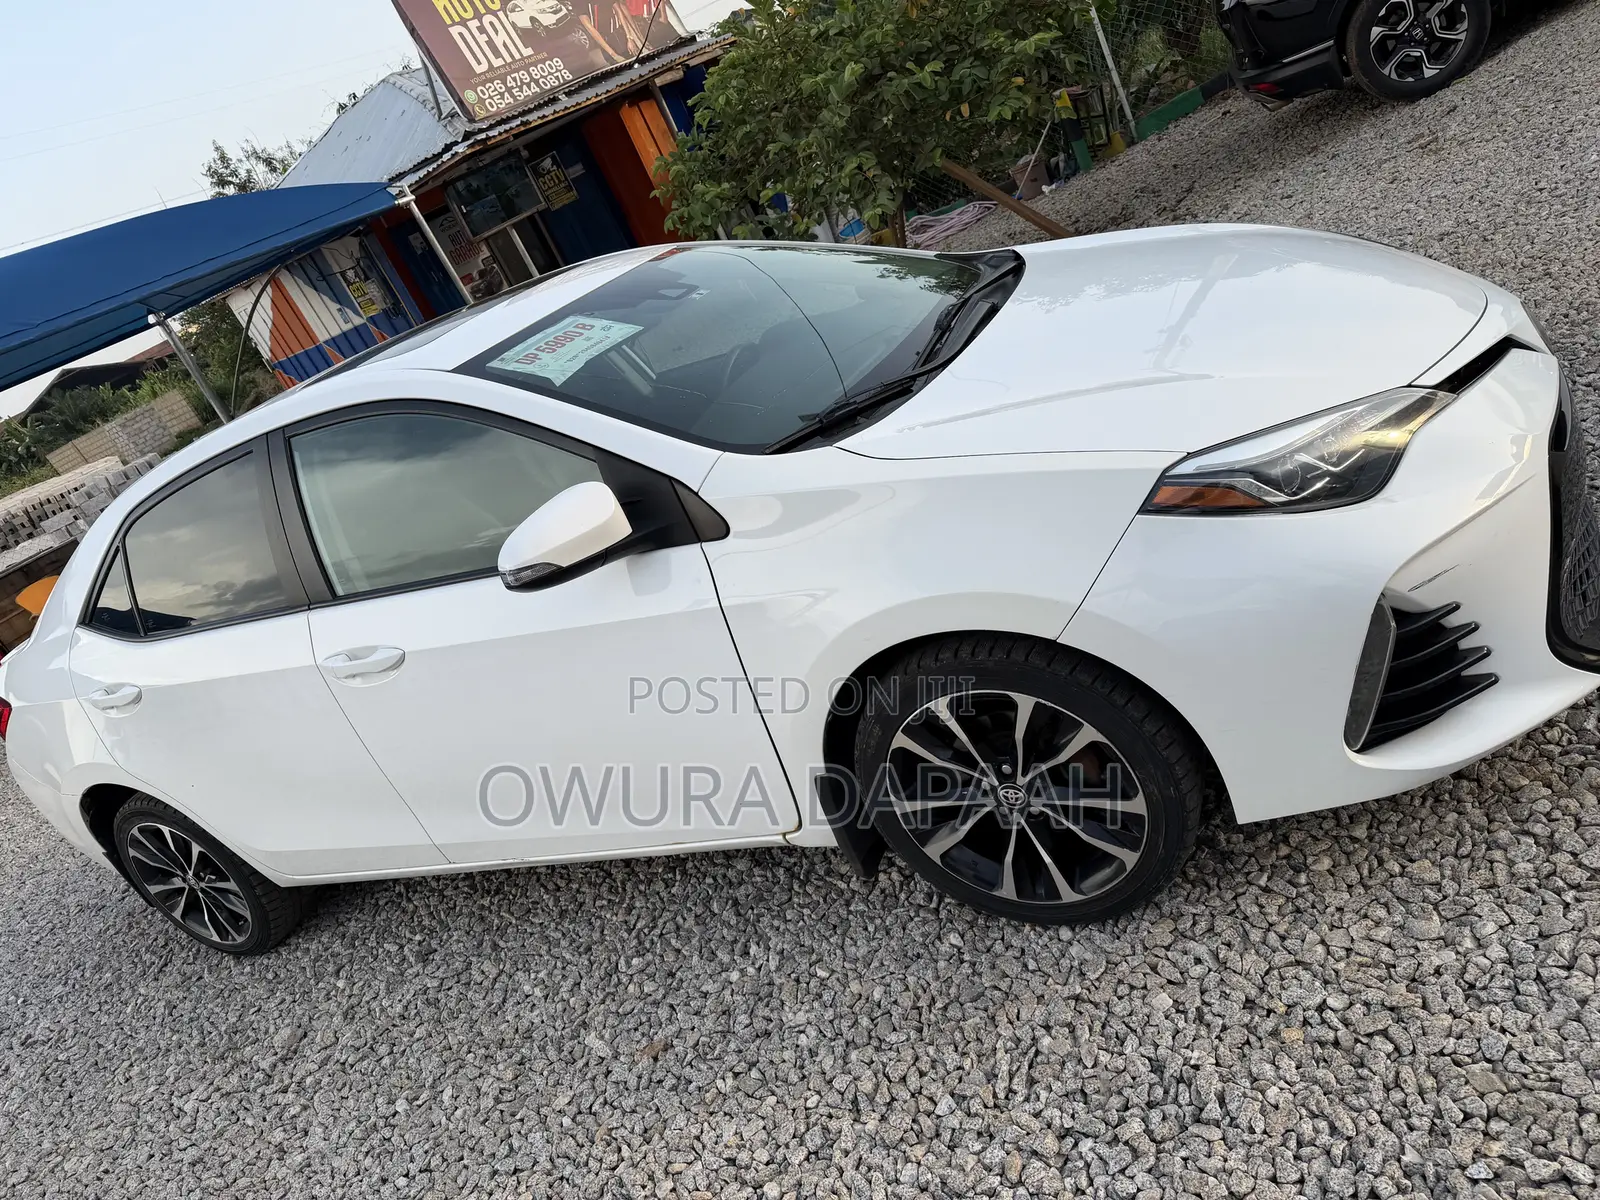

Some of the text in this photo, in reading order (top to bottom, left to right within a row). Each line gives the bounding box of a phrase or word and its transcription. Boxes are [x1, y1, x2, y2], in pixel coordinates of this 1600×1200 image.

[448, 11, 534, 74] DEAL
[470, 51, 548, 84] YOUR RELIABLE AUTO PARTNER
[477, 57, 564, 99] 026 479 8009
[485, 69, 573, 111] 054 544 0878
[538, 168, 565, 190] CCTV
[448, 229, 467, 248] AUT
[515, 352, 542, 365] DP
[534, 330, 584, 354] 5990
[572, 323, 595, 331] B
